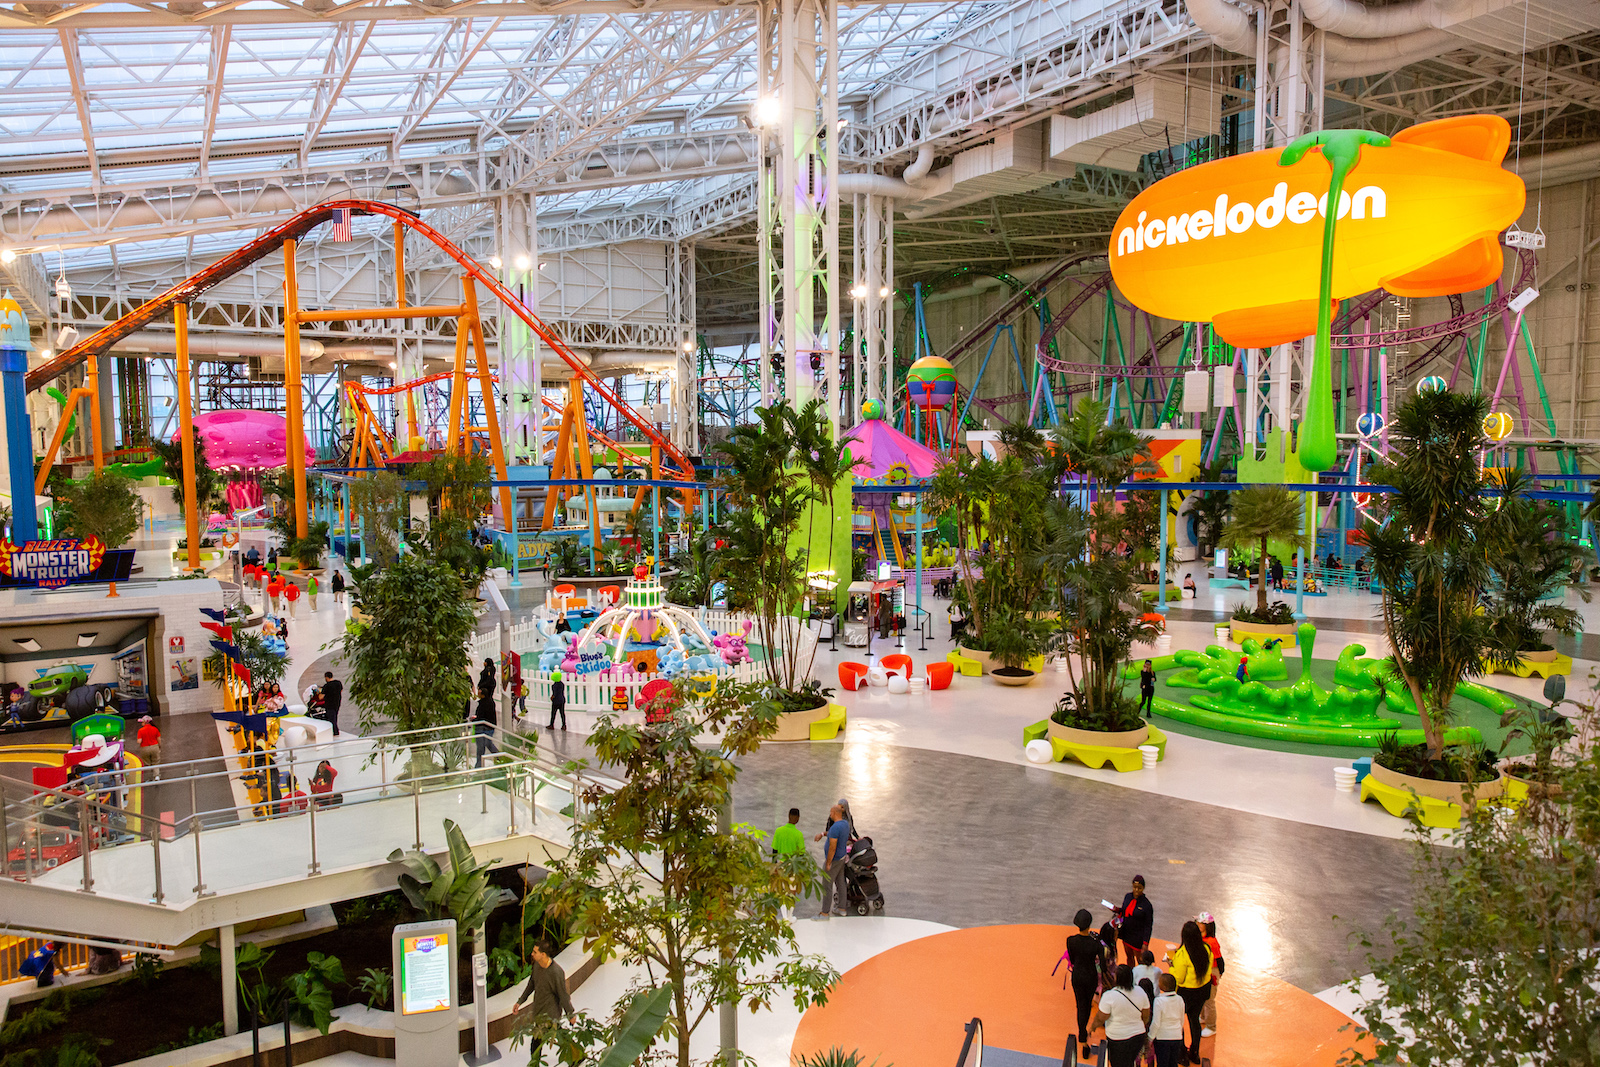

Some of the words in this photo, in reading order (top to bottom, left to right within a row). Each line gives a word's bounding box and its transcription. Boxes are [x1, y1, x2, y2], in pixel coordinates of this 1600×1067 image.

[1118, 182, 1386, 256] nickelodeon
[517, 543, 557, 560] ADVE
[12, 550, 89, 578] MONSTER
[27, 566, 79, 580] TRUCK
[38, 579, 68, 587] RALLY
[580, 651, 604, 662] Blue's
